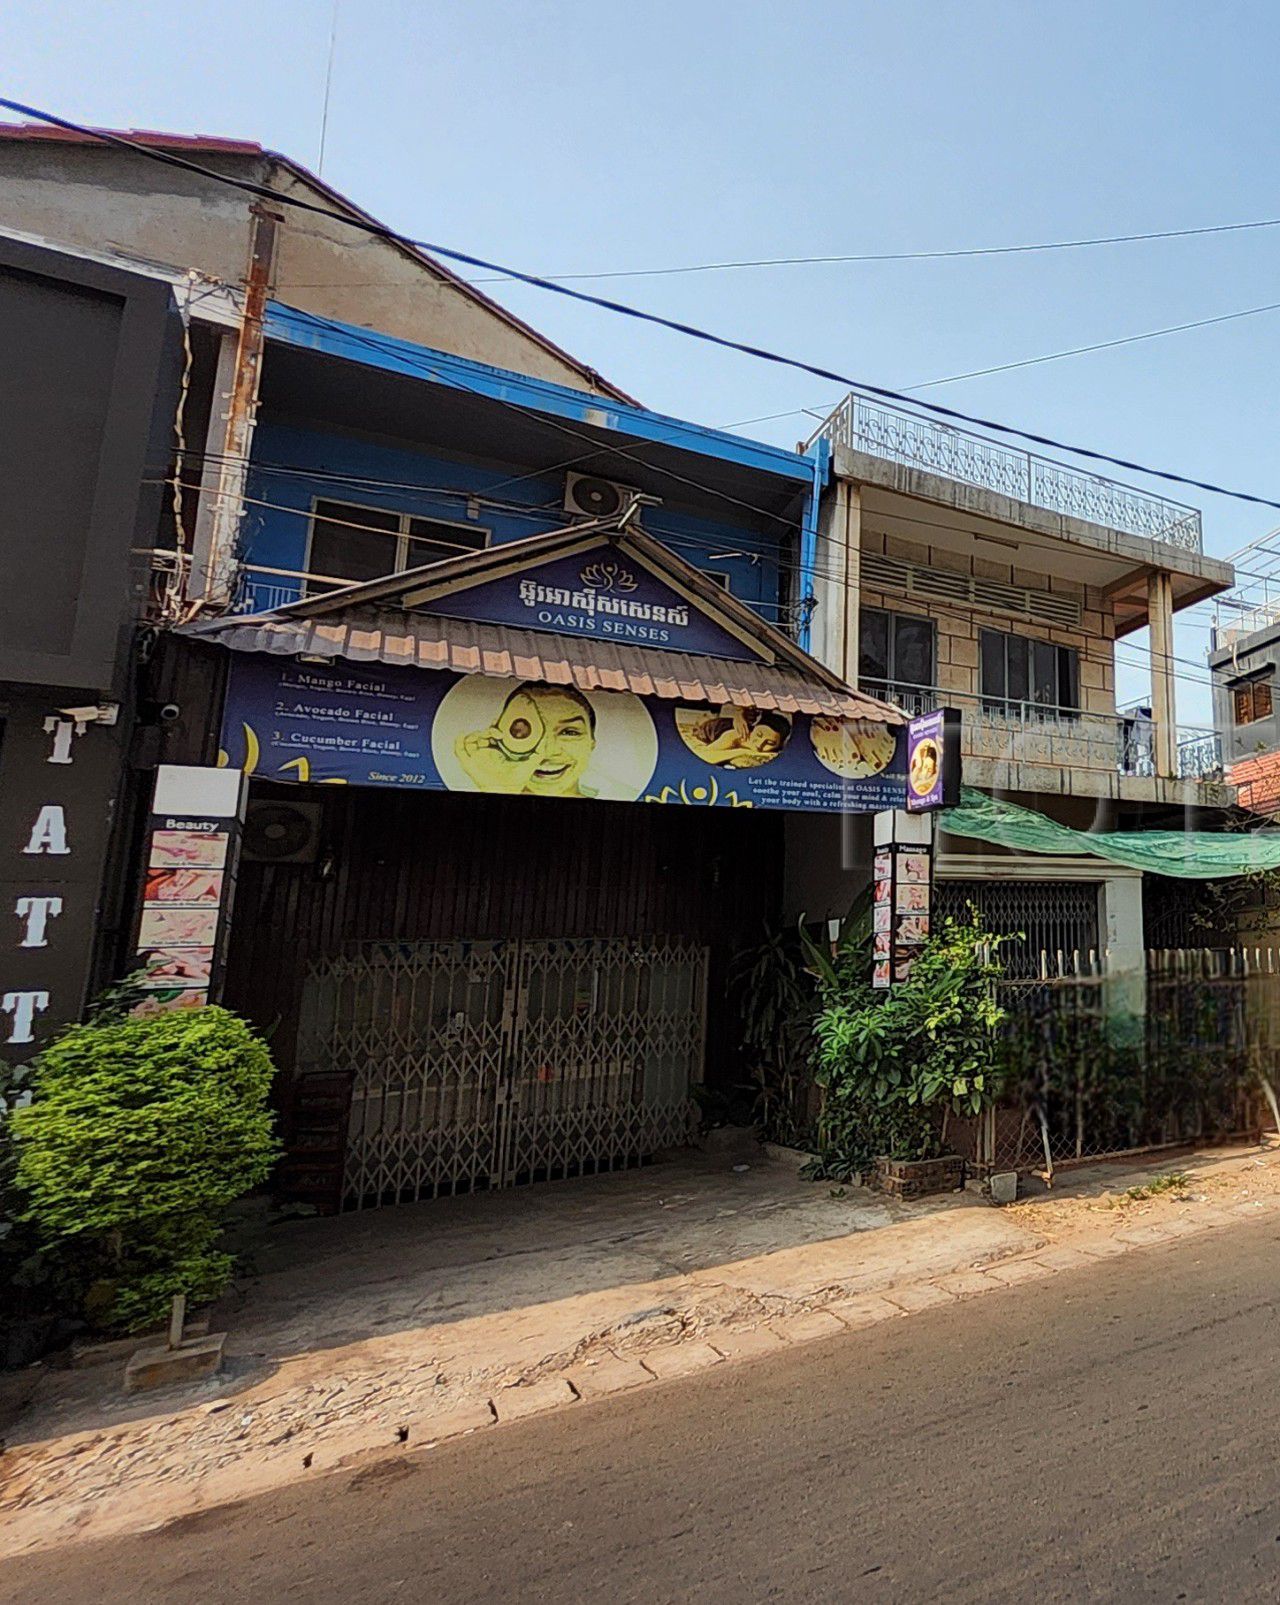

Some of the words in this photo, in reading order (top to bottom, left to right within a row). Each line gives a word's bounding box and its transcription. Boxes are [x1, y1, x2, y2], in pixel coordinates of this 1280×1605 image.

[538, 611, 596, 630] OASIS
[602, 621, 670, 641] SENSES
[298, 674, 343, 687] Mango
[347, 679, 386, 692] Facial
[293, 703, 350, 717] Avocado
[355, 709, 394, 721] Facial
[291, 732, 358, 747] Cucumber
[362, 738, 400, 750] Facial
[367, 771, 398, 782] Since
[399, 773, 426, 784] 2012
[166, 819, 219, 832] Beauty
[1, 713, 89, 1108] TATT
